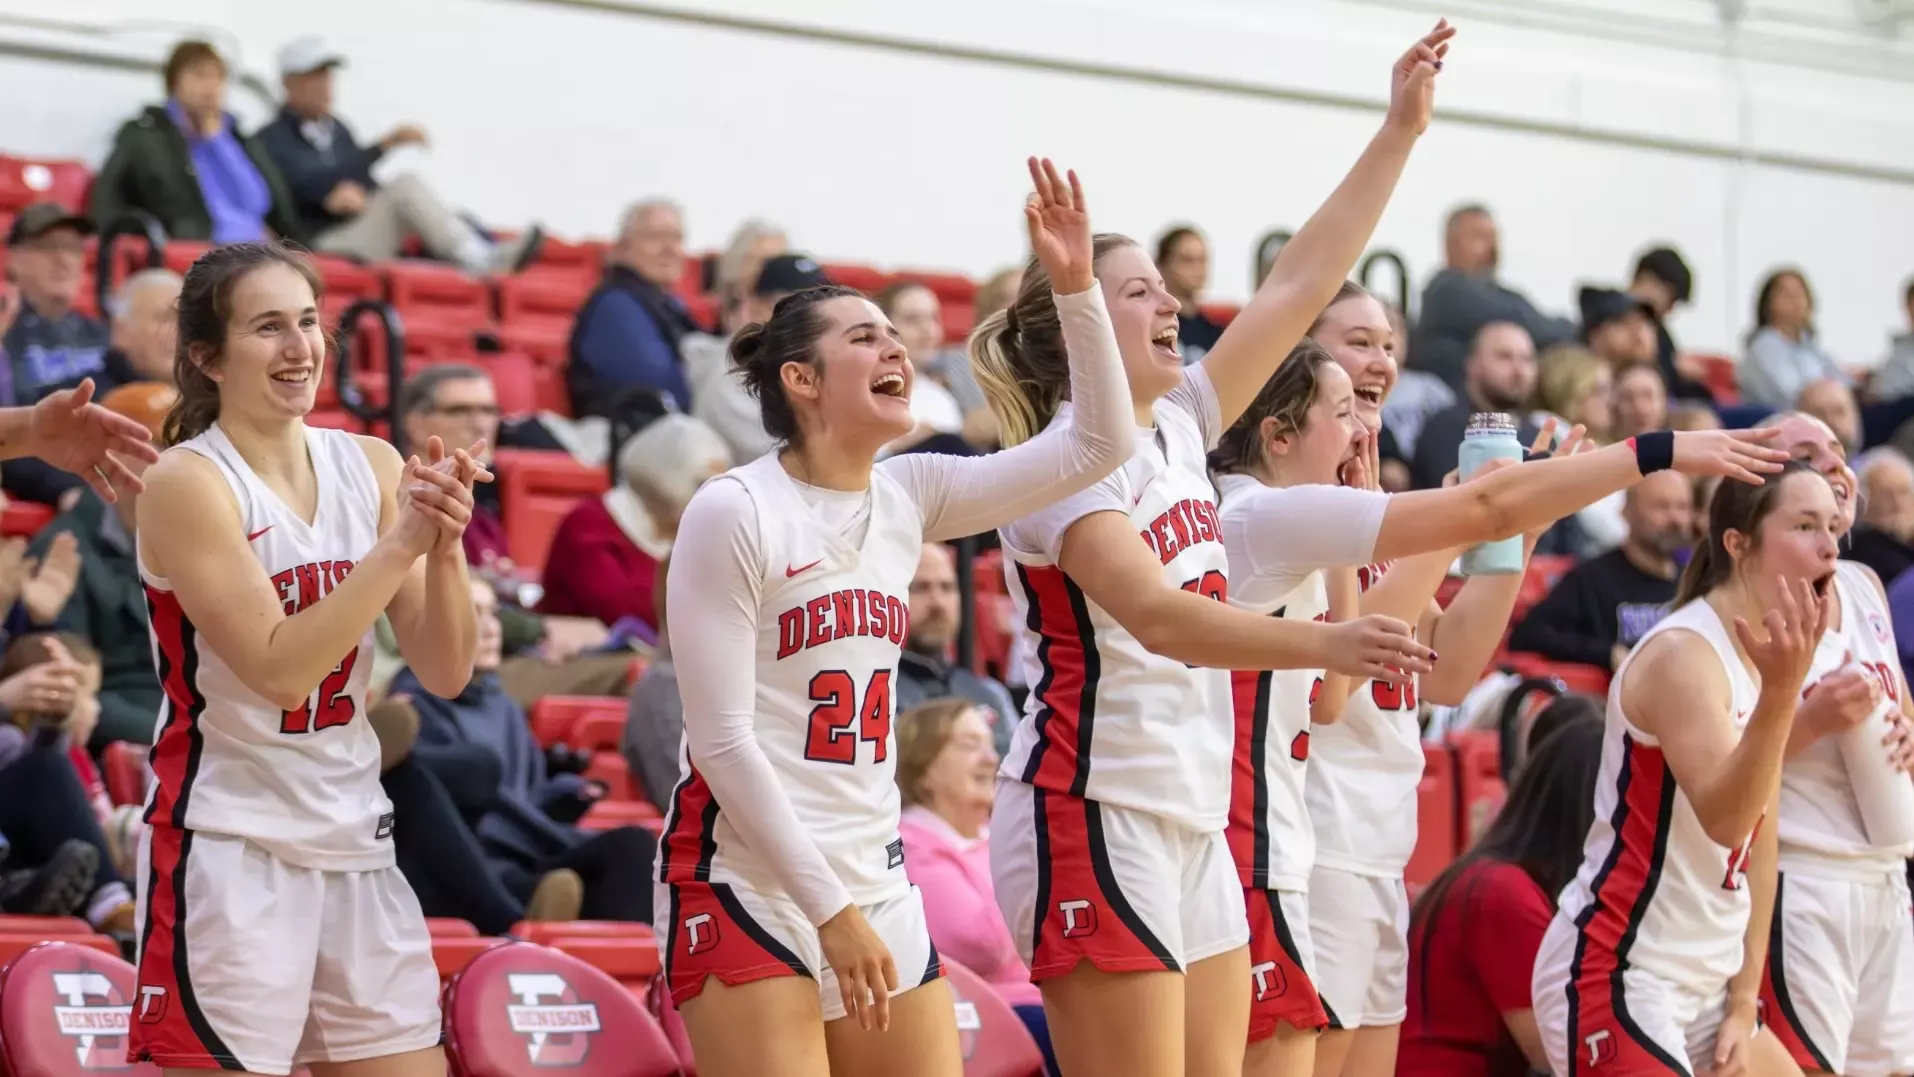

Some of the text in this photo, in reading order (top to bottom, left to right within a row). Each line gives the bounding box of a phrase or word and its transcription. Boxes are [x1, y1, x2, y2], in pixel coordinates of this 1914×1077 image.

[1140, 498, 1224, 566] ENISO
[804, 668, 891, 766] 24
[684, 912, 721, 956] D
[1058, 898, 1099, 939] D
[60, 1010, 131, 1029] DENISO
[514, 1008, 594, 1027] DENISON
